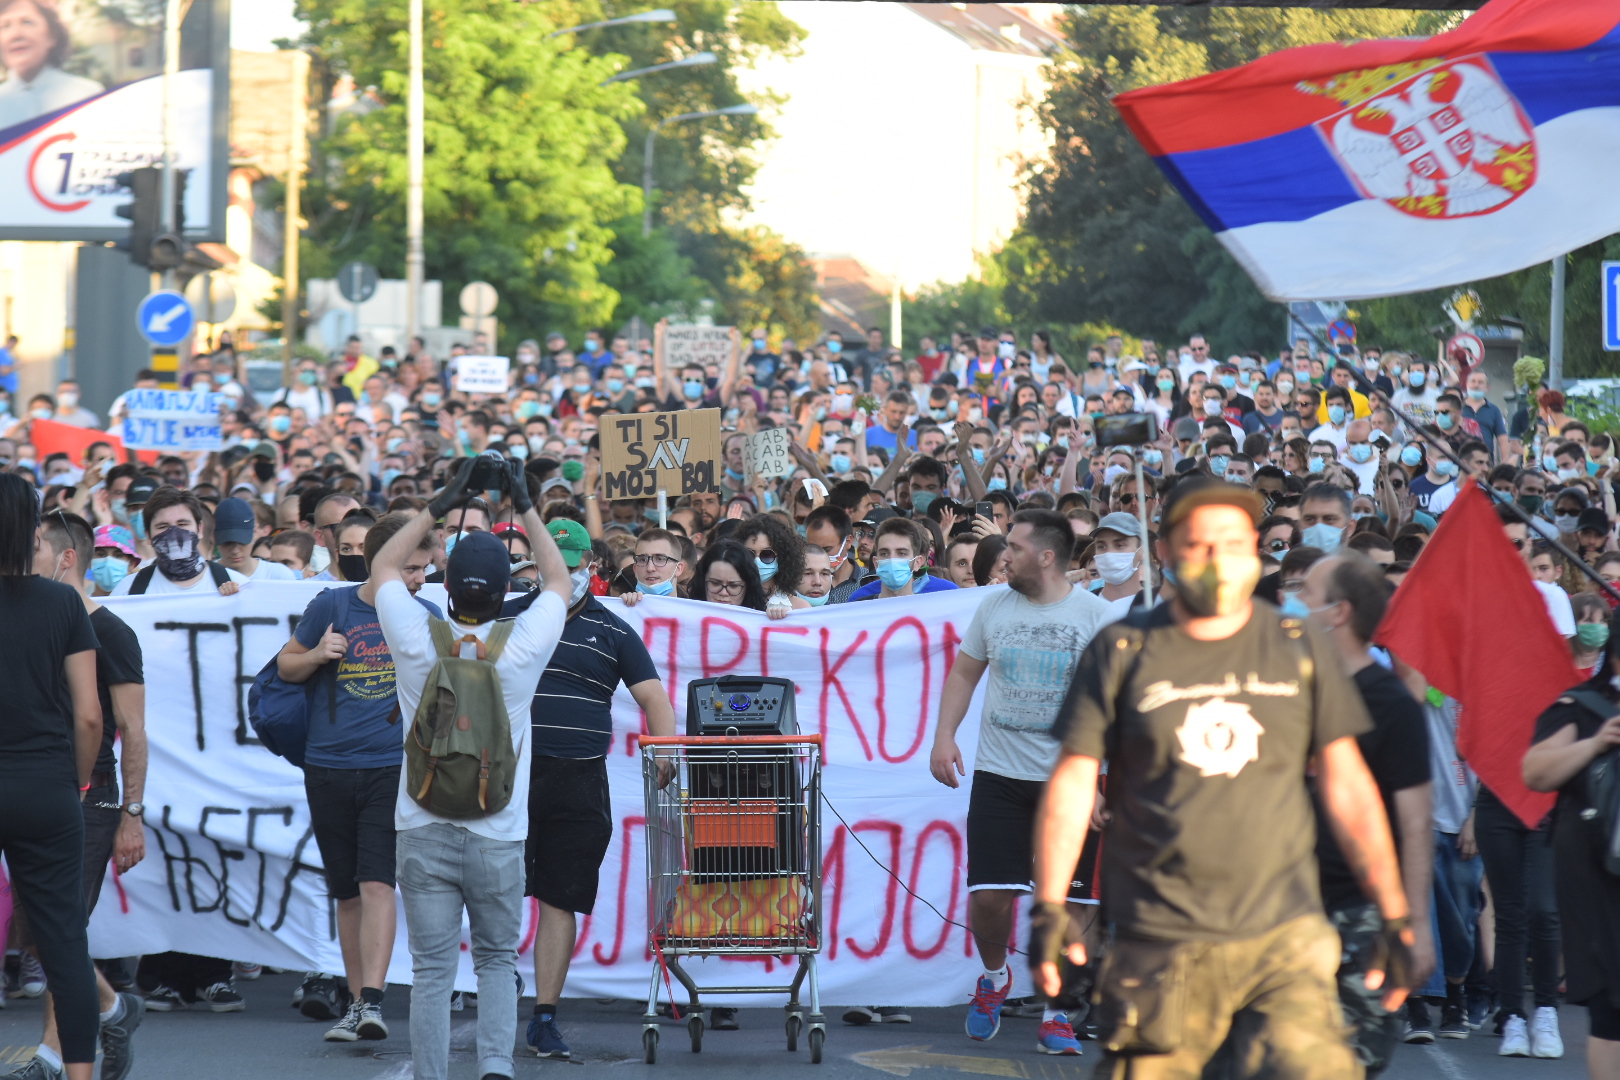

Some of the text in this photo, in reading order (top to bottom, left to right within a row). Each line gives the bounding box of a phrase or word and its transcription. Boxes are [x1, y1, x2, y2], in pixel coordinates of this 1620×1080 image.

[616, 414, 678, 443] TI SI
[626, 438, 690, 471] SAV
[605, 460, 722, 498] MOJ BOL
[346, 625, 363, 636] MADE
[354, 641, 391, 658] Custo
